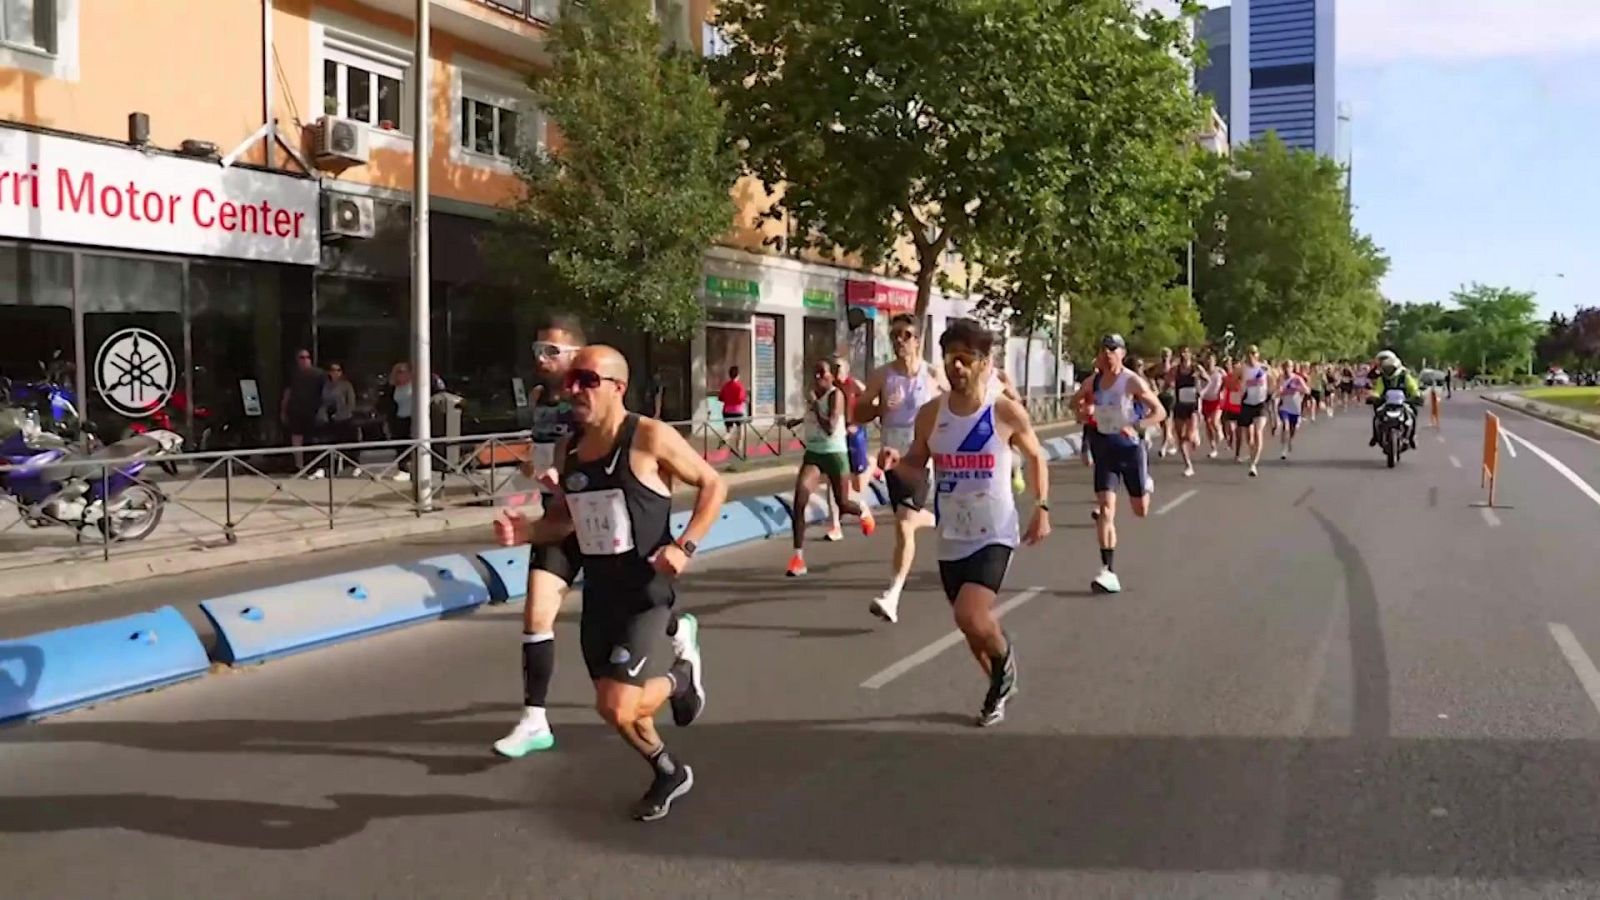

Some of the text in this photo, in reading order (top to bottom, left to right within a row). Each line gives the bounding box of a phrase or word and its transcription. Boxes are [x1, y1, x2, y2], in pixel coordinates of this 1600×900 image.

[57, 168, 181, 224] Motor
[193, 188, 304, 238] Center
[935, 453, 995, 469] MADRID
